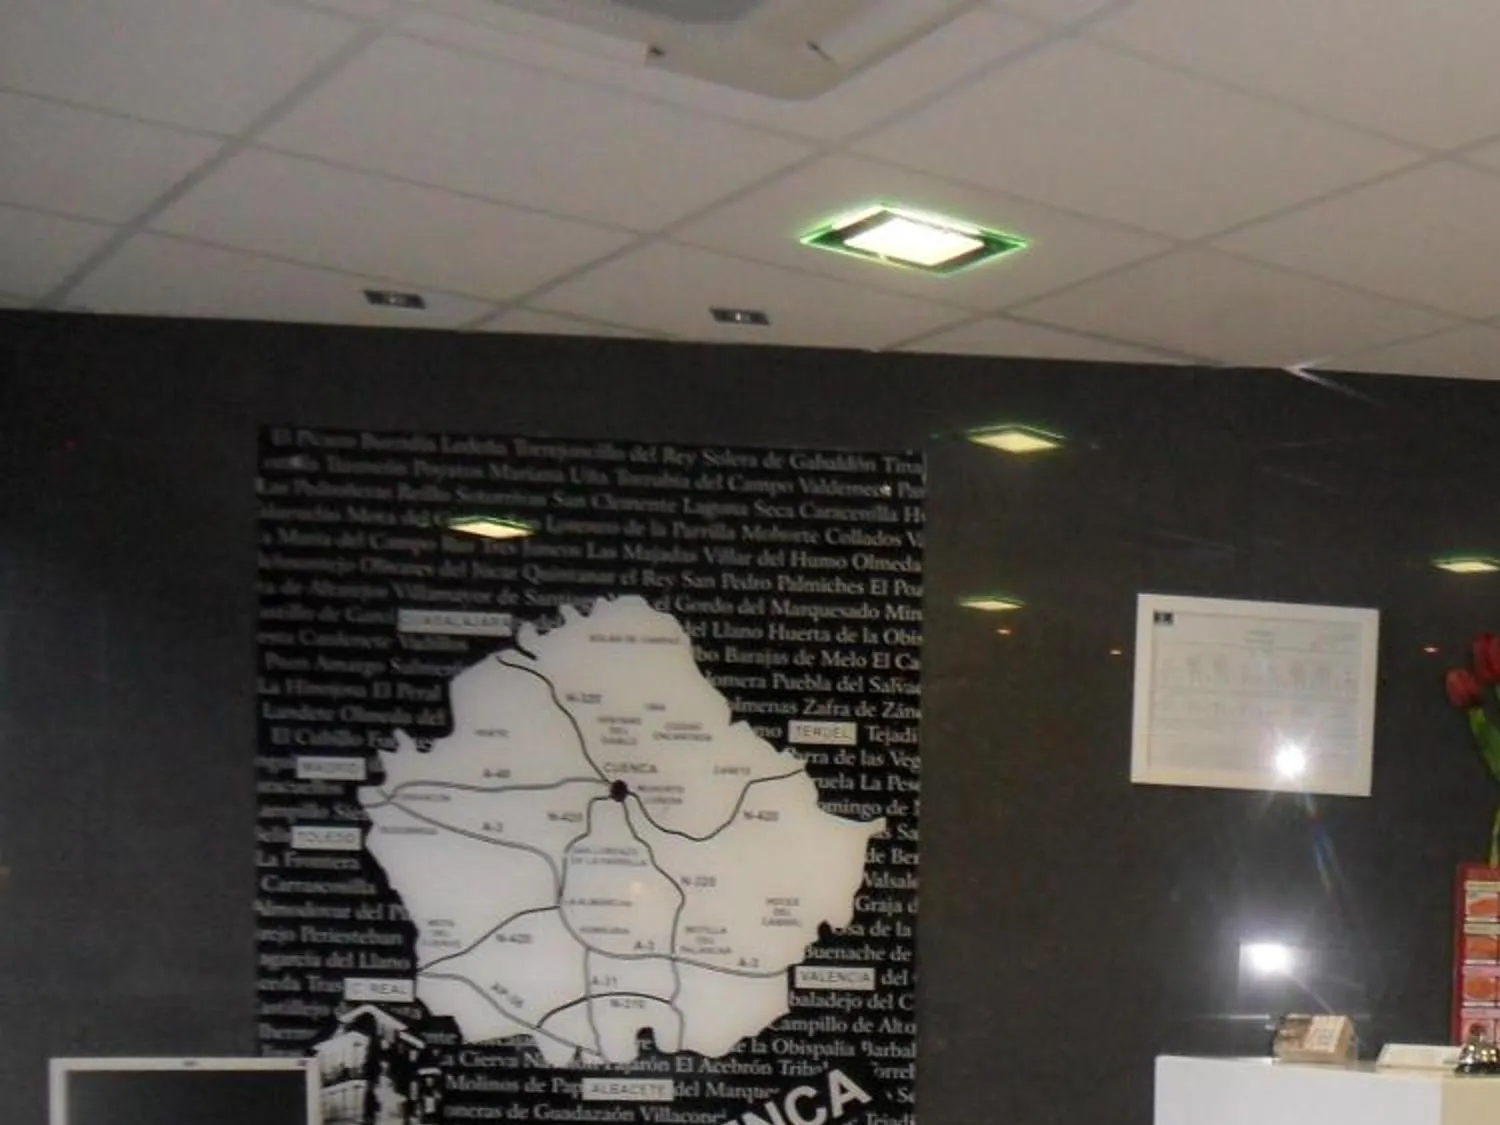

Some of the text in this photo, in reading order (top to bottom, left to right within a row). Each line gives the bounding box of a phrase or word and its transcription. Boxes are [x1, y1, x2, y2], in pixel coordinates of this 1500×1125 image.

[762, 450, 784, 469] de
[757, 549, 785, 568] del
[789, 550, 848, 571] Humo
[851, 552, 923, 573] Olmeda
[680, 571, 716, 590] San
[720, 572, 773, 592] Pedro
[776, 575, 864, 596] Palmiches
[869, 578, 888, 596] El
[737, 597, 765, 616] del
[770, 598, 880, 623] Marquesado
[712, 621, 763, 641] Llano
[768, 622, 832, 643] Huerta
[836, 625, 857, 644] de
[863, 626, 878, 645] la
[725, 646, 788, 668] Barajas
[793, 648, 815, 667] de
[820, 649, 866, 668] Melo
[871, 651, 890, 669] El
[772, 671, 831, 692] Puebla
[836, 675, 864, 693] del
[803, 698, 850, 718] Zafra
[855, 700, 876, 718] de
[796, 720, 850, 738] TERUEL
[604, 762, 659, 774] CUENCA
[833, 750, 856, 768] de
[861, 750, 884, 768] las
[860, 774, 881, 792] La
[886, 801, 908, 818] de
[854, 895, 904, 917] Graja
[869, 921, 913, 938] de la
[889, 945, 912, 962] de
[799, 969, 872, 984] VALENCIA
[880, 969, 909, 987] del
[866, 993, 893, 1010] del
[851, 1018, 873, 1034] de
[751, 1039, 767, 1054] la
[675, 1055, 693, 1073] El
[445, 1073, 520, 1092] Molinos
[525, 1076, 545, 1094] de
[592, 1081, 666, 1096] ALBACETE
[674, 1081, 700, 1097] del
[506, 1103, 528, 1120] de
